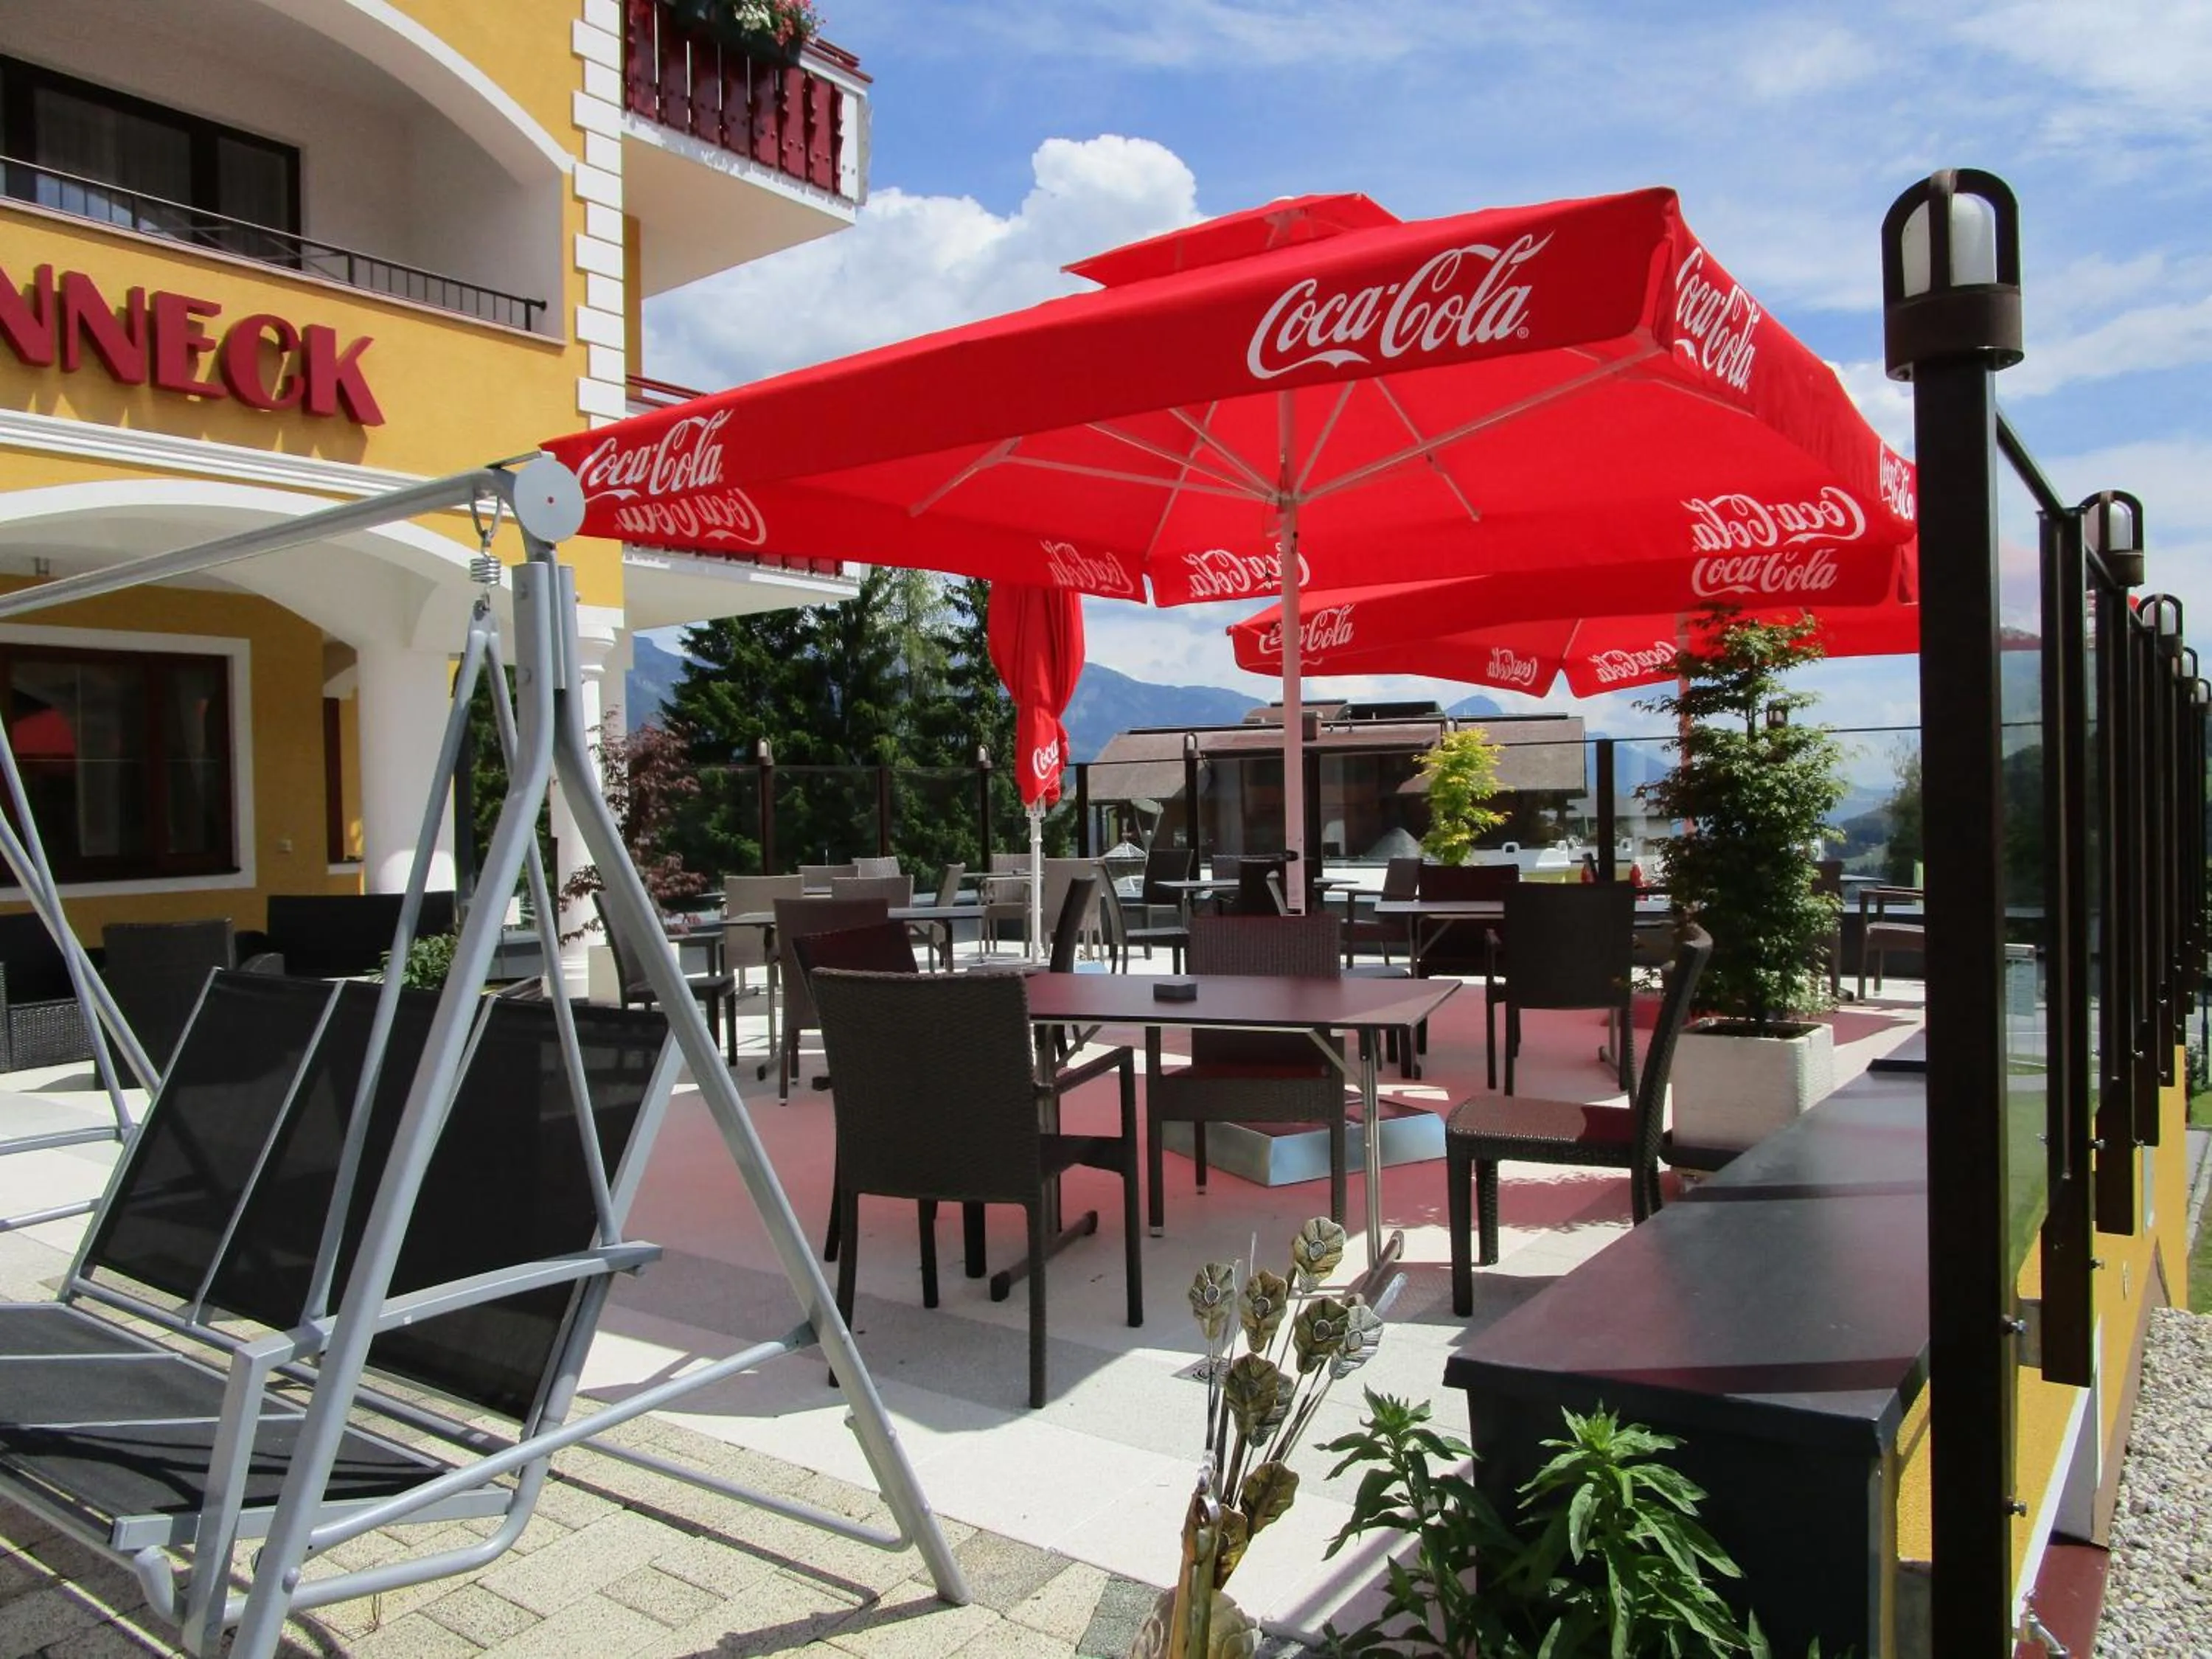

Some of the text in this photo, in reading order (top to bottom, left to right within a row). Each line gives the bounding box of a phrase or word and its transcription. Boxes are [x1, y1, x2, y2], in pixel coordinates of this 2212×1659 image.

[1246, 230, 1555, 380] Coca-Cola
[1675, 246, 1762, 392] Coca-Cola
[576, 408, 734, 500] Coca-Cola
[1259, 603, 1356, 654] Co-Cola
